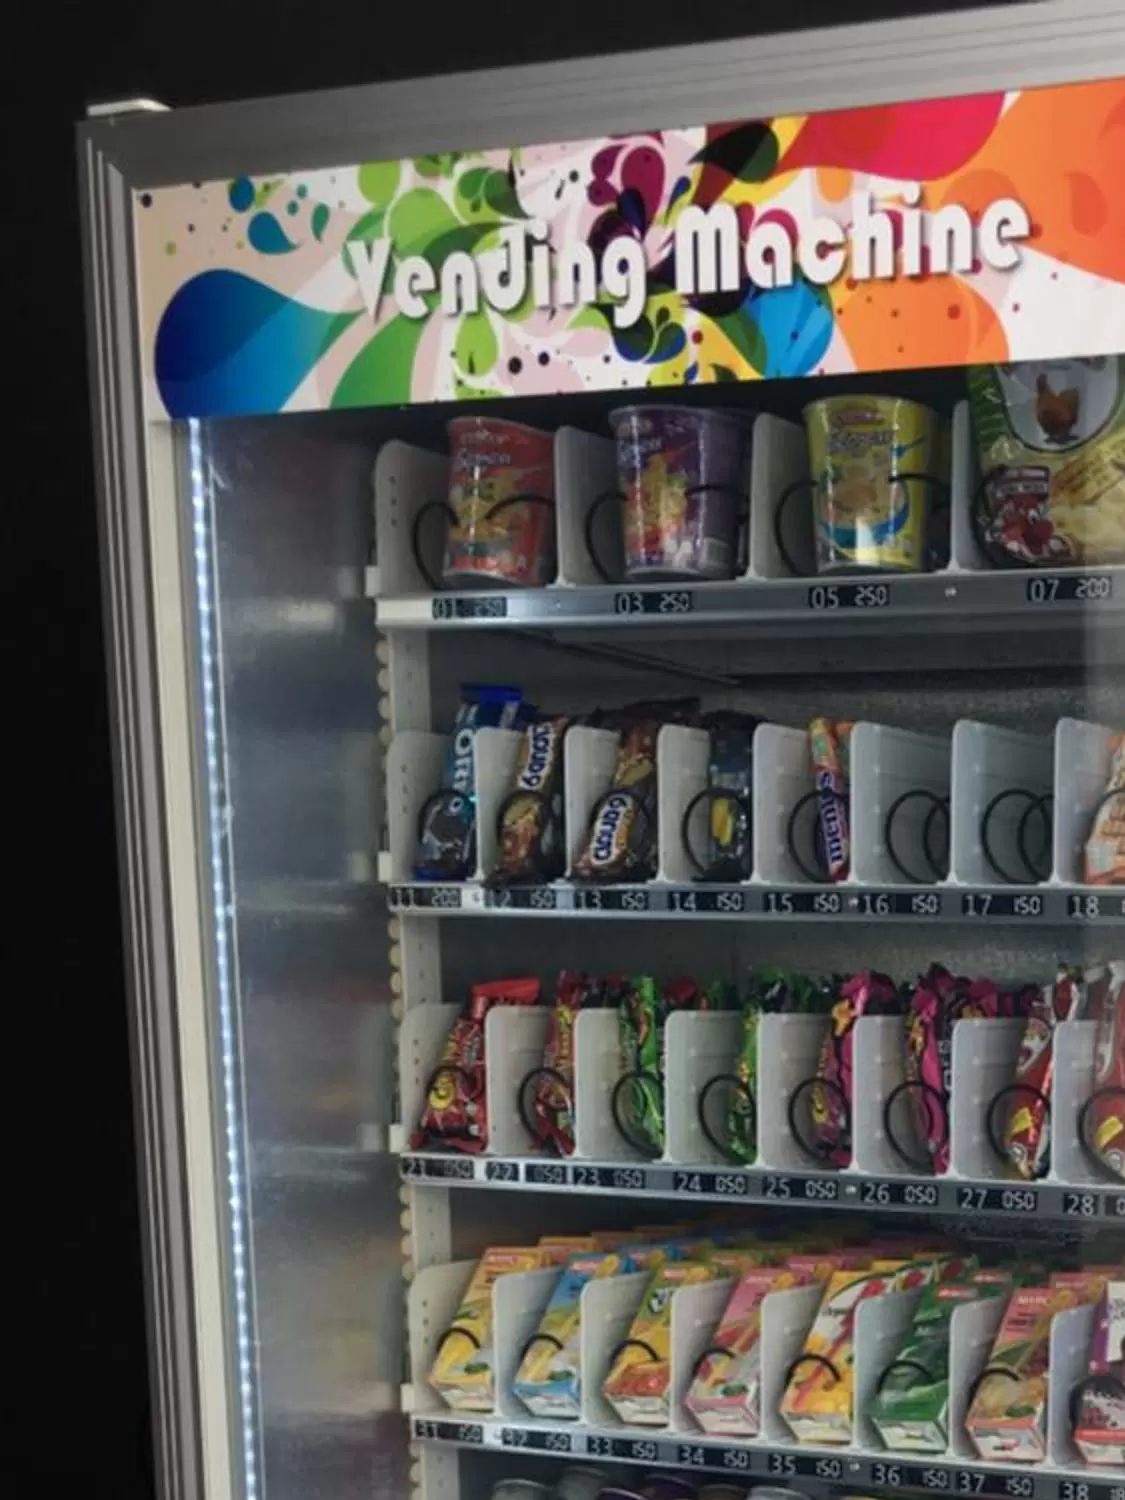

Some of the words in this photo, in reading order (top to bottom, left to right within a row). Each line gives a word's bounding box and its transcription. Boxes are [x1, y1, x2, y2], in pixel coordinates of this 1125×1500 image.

[347, 218, 648, 328] Vending
[674, 184, 1032, 296] Machine
[811, 587, 839, 608] 05
[1028, 580, 1058, 601] 07
[616, 592, 645, 613] 03
[671, 892, 696, 911] 14
[767, 893, 793, 912] 15
[863, 894, 889, 914] 16
[966, 895, 993, 915] 17
[1071, 895, 1100, 917] 18
[675, 1174, 701, 1193] 24
[766, 1179, 791, 1198] 25
[864, 1183, 891, 1203] 26
[961, 1189, 988, 1209] 27
[1067, 1194, 1096, 1216] 28
[770, 1455, 797, 1475] 35
[874, 1465, 901, 1486] 36
[959, 1474, 985, 1493] 37
